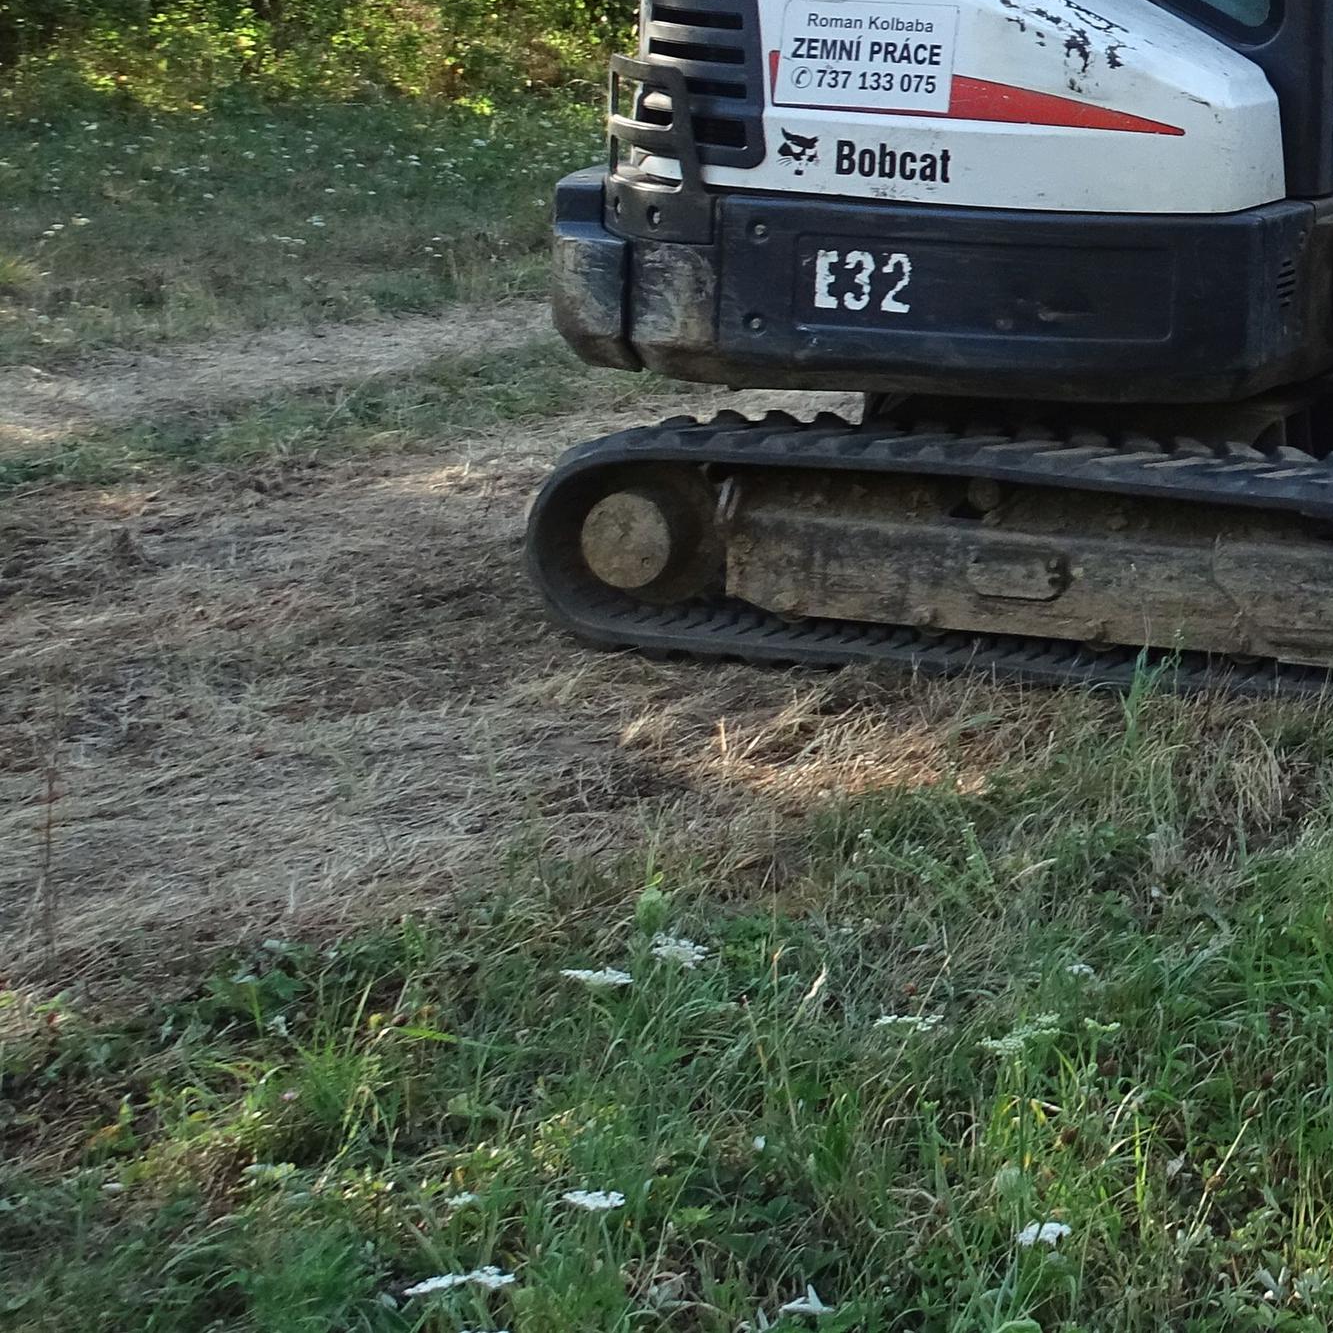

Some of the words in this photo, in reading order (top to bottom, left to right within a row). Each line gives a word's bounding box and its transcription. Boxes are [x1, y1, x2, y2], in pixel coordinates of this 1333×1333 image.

[807, 13, 863, 29] Roman
[868, 16, 934, 33] Kolbaba
[791, 35, 863, 61] ZEMNÍ
[869, 38, 943, 65] PRÁCE
[816, 69, 852, 89] 737
[858, 72, 894, 91] 133
[900, 74, 936, 94] 075
[836, 140, 951, 183] Bobcat
[814, 249, 912, 313] E32
